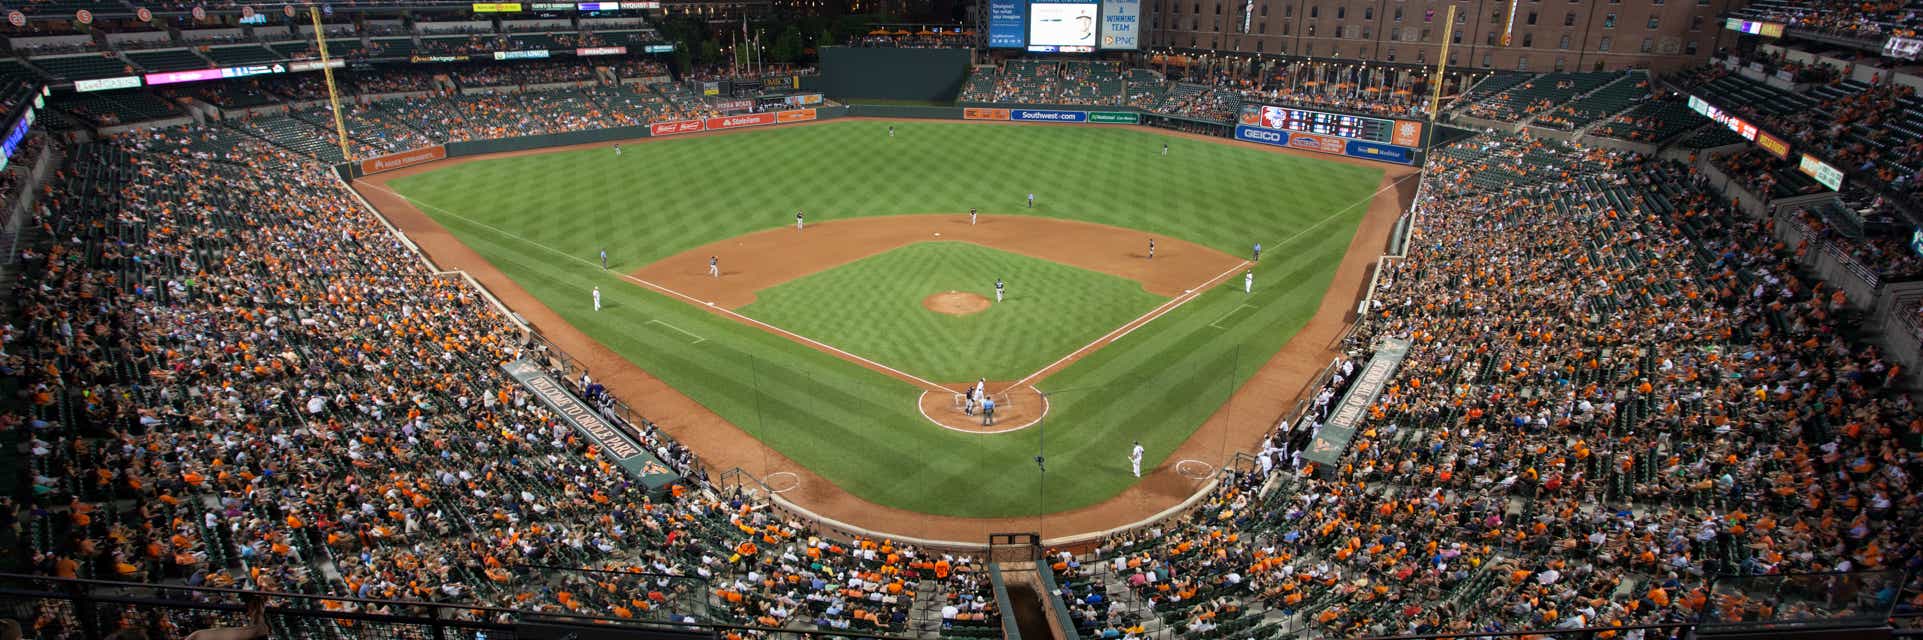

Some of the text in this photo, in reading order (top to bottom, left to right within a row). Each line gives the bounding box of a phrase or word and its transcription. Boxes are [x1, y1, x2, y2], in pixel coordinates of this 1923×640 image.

[1115, 36, 1135, 45] PNC
[1244, 129, 1280, 142] GEICO
[530, 376, 640, 459] WELCOME TO ORIOLE PARK
[1333, 404, 1360, 427] HOME
[1354, 381, 1377, 397] THE
